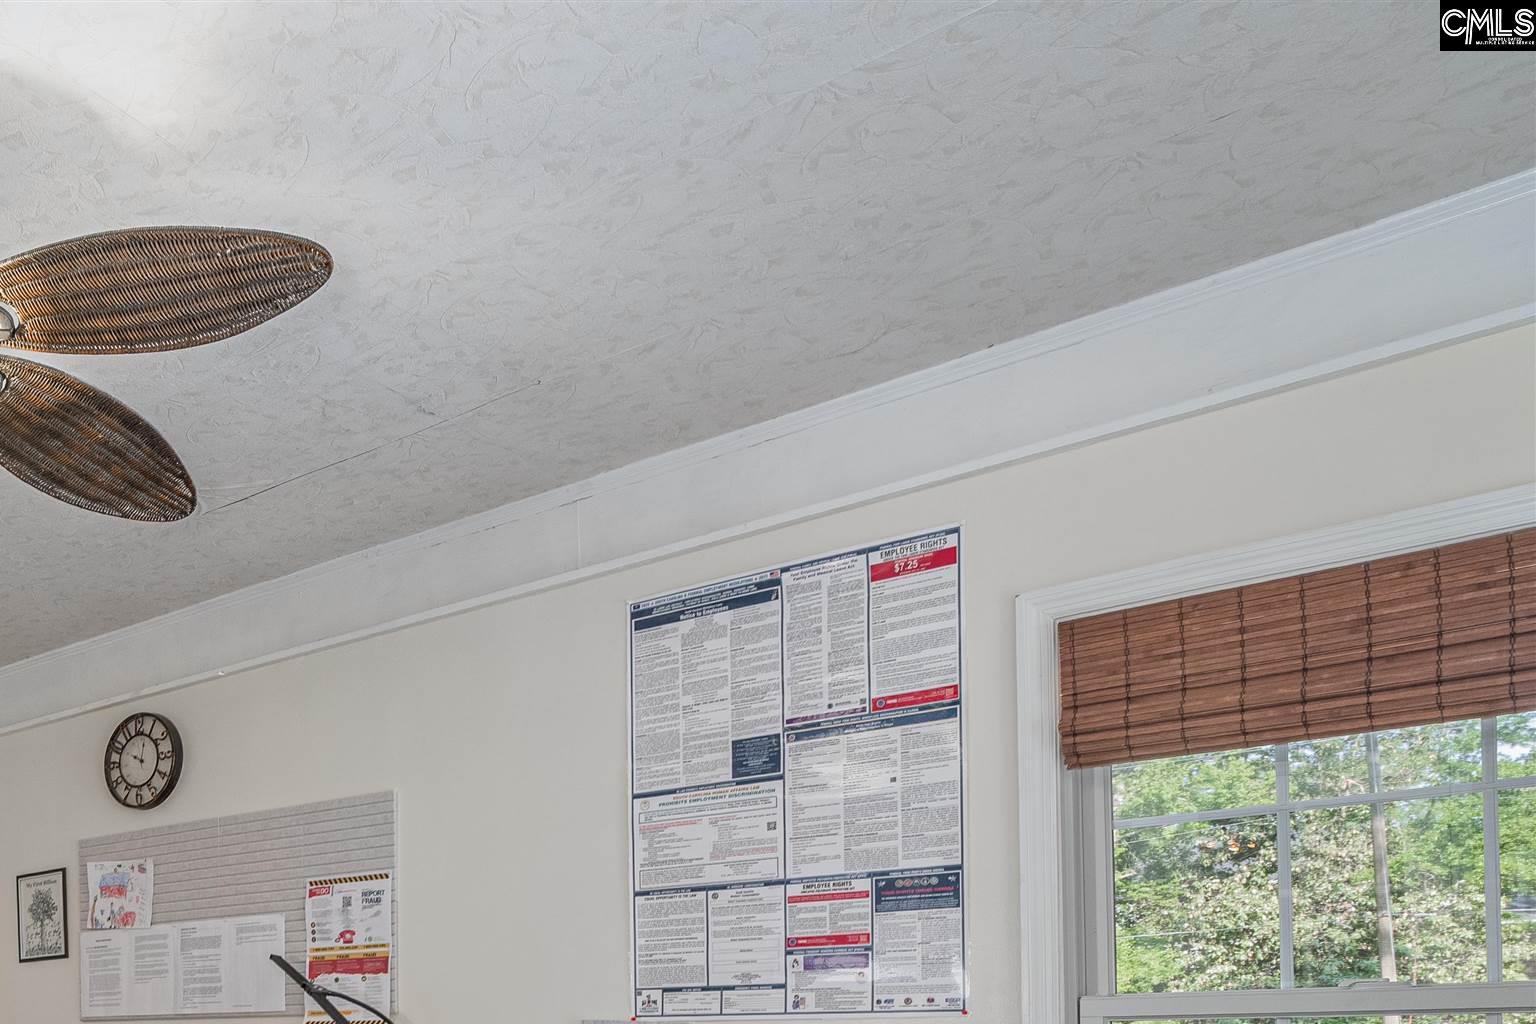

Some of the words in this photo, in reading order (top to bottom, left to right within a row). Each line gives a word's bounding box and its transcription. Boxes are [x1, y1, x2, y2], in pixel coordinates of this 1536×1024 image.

[880, 543, 919, 559] EMPLOYEE
[920, 537, 948, 550] RIGHTS
[894, 559, 919, 574] $7.25
[802, 882, 830, 890] EMPLOYEE
[832, 880, 852, 888] RIGHTS
[362, 889, 385, 897] REPORT
